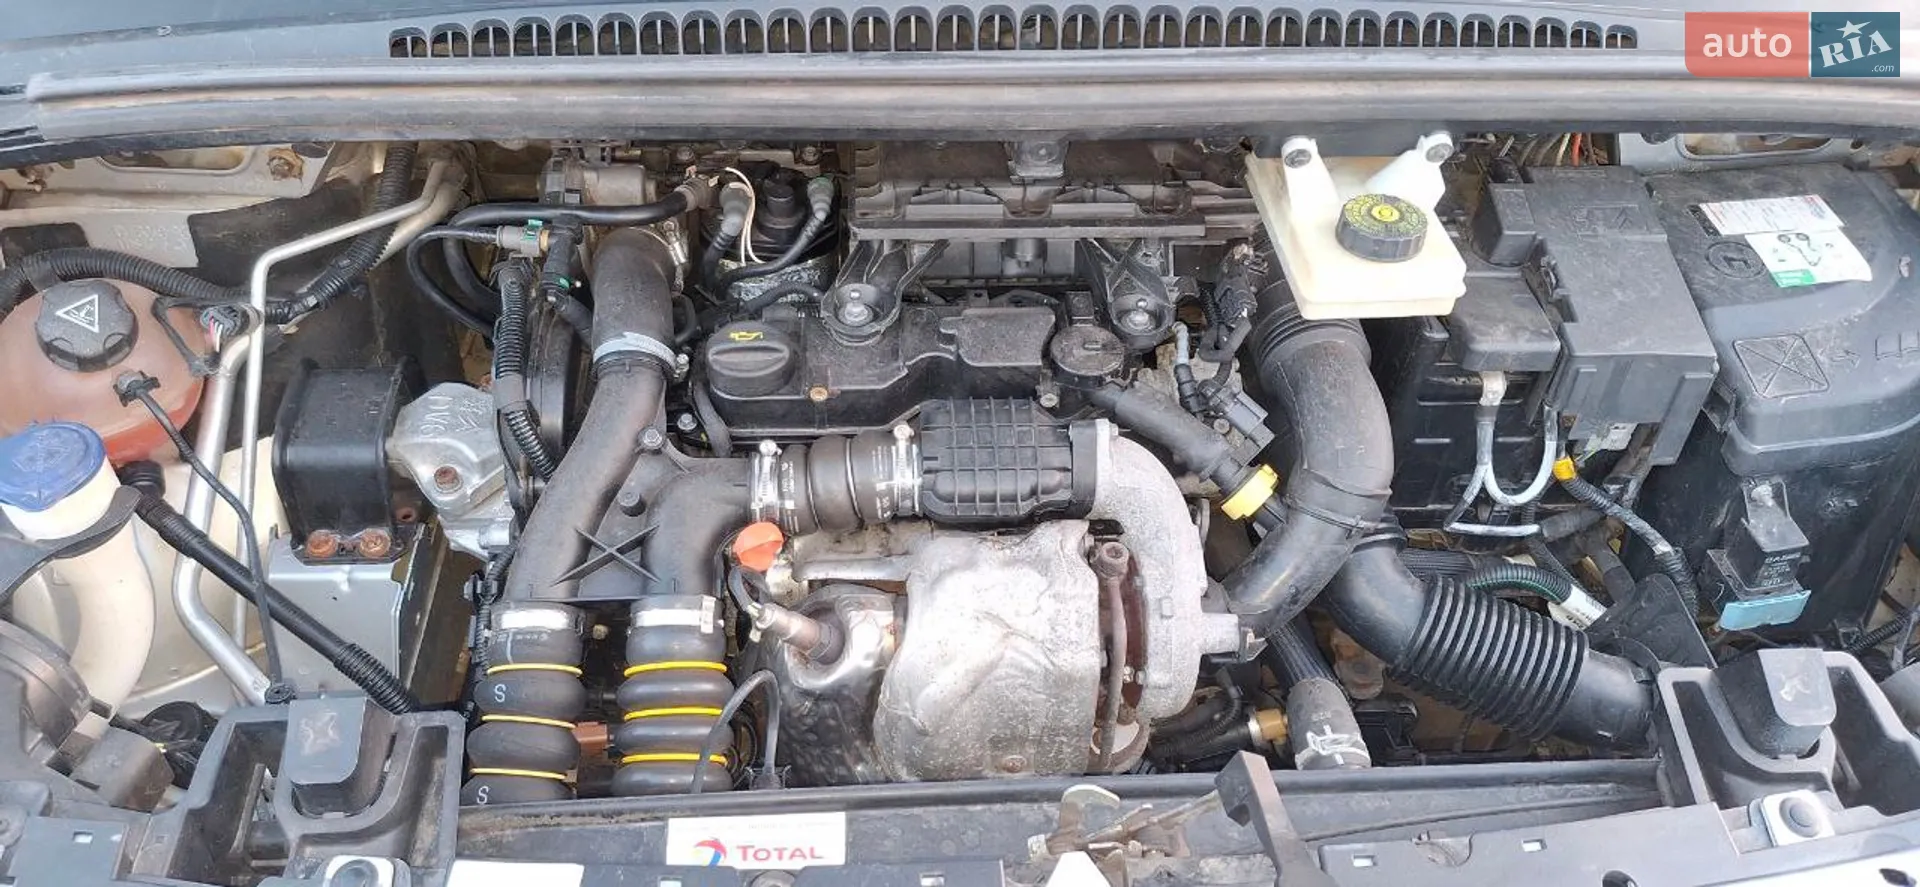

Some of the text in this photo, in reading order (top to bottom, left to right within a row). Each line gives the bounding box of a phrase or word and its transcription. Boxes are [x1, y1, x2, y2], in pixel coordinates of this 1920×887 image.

[494, 683, 507, 702] S
[476, 785, 489, 805] S
[736, 845, 825, 862] TOTAL
